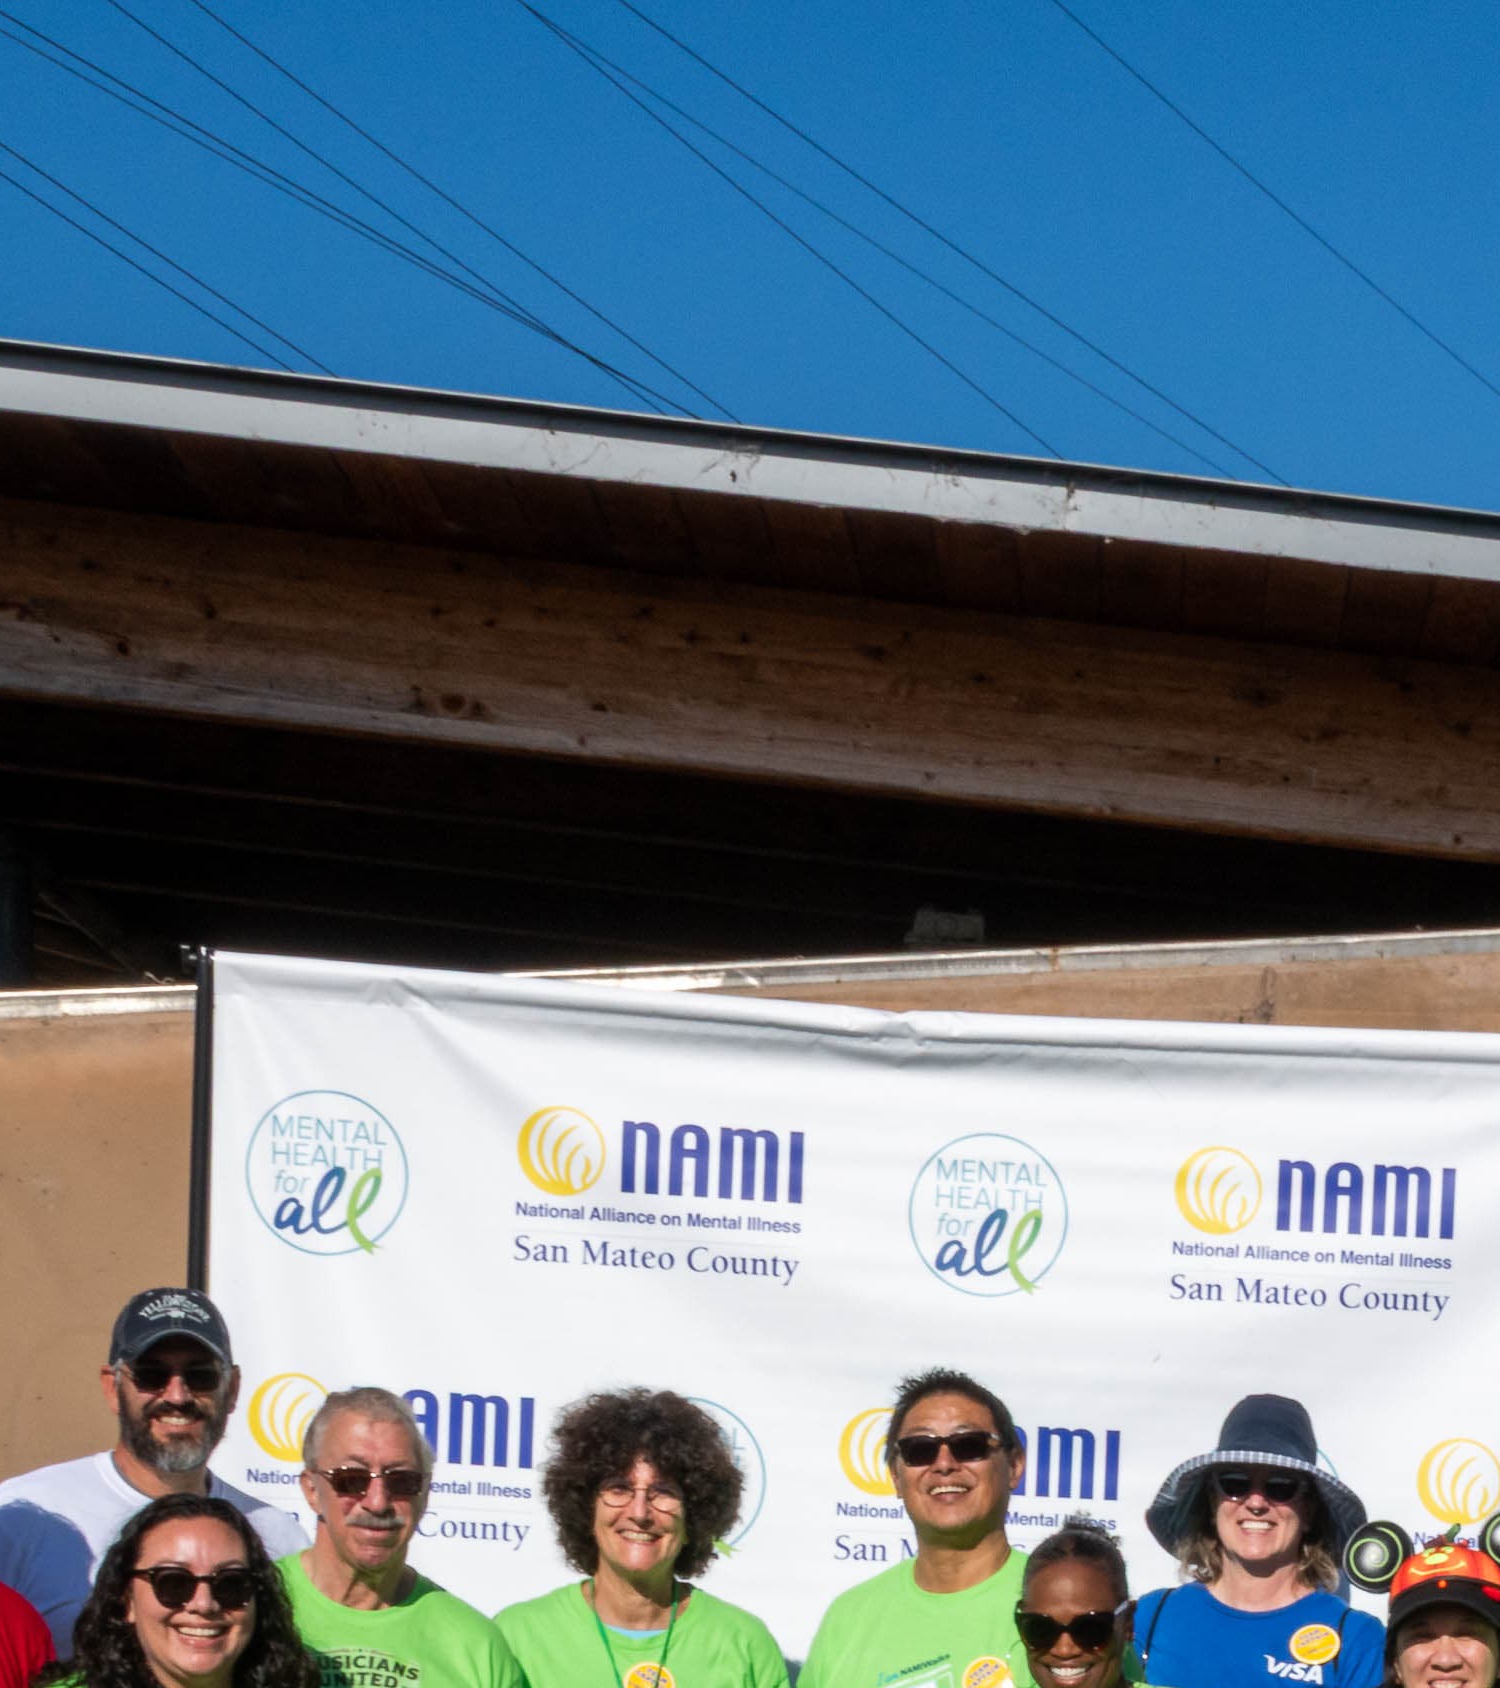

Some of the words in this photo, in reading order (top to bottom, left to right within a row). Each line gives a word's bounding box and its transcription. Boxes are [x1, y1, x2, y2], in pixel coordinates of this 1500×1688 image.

[271, 1114, 387, 1146] MENTAL
[270, 1142, 383, 1171] HEALTH
[620, 1120, 805, 1204] NAMI
[936, 1157, 1048, 1187] MENTAL
[274, 1170, 311, 1194] for
[273, 1166, 384, 1255] all
[934, 1184, 1044, 1212] HEALTH
[1276, 1159, 1457, 1240] NAMI
[515, 1202, 585, 1220] National
[590, 1206, 656, 1225] Alliance
[660, 1213, 682, 1227] on
[687, 1213, 742, 1230] Mental
[747, 1216, 801, 1234] Illness
[936, 1213, 974, 1237] for
[513, 1235, 568, 1264] San
[581, 1239, 675, 1271] Mateo
[687, 1246, 800, 1287] County
[935, 1208, 1043, 1295] all
[1172, 1241, 1240, 1259] National
[1244, 1244, 1310, 1263] Alliance
[1315, 1251, 1336, 1264] on
[1340, 1250, 1394, 1267] Mental
[1399, 1253, 1453, 1270] Illness
[1169, 1273, 1223, 1302] San
[1235, 1277, 1327, 1307] Mateo
[1339, 1282, 1451, 1321] County
[246, 1468, 300, 1485] Nation
[430, 1480, 472, 1496] ental
[477, 1482, 532, 1499] Illness
[836, 1502, 905, 1520] National
[1005, 1511, 1059, 1527] Mental
[415, 1511, 531, 1552] County
[833, 1534, 887, 1562] San
[1263, 1653, 1324, 1686] VISA
